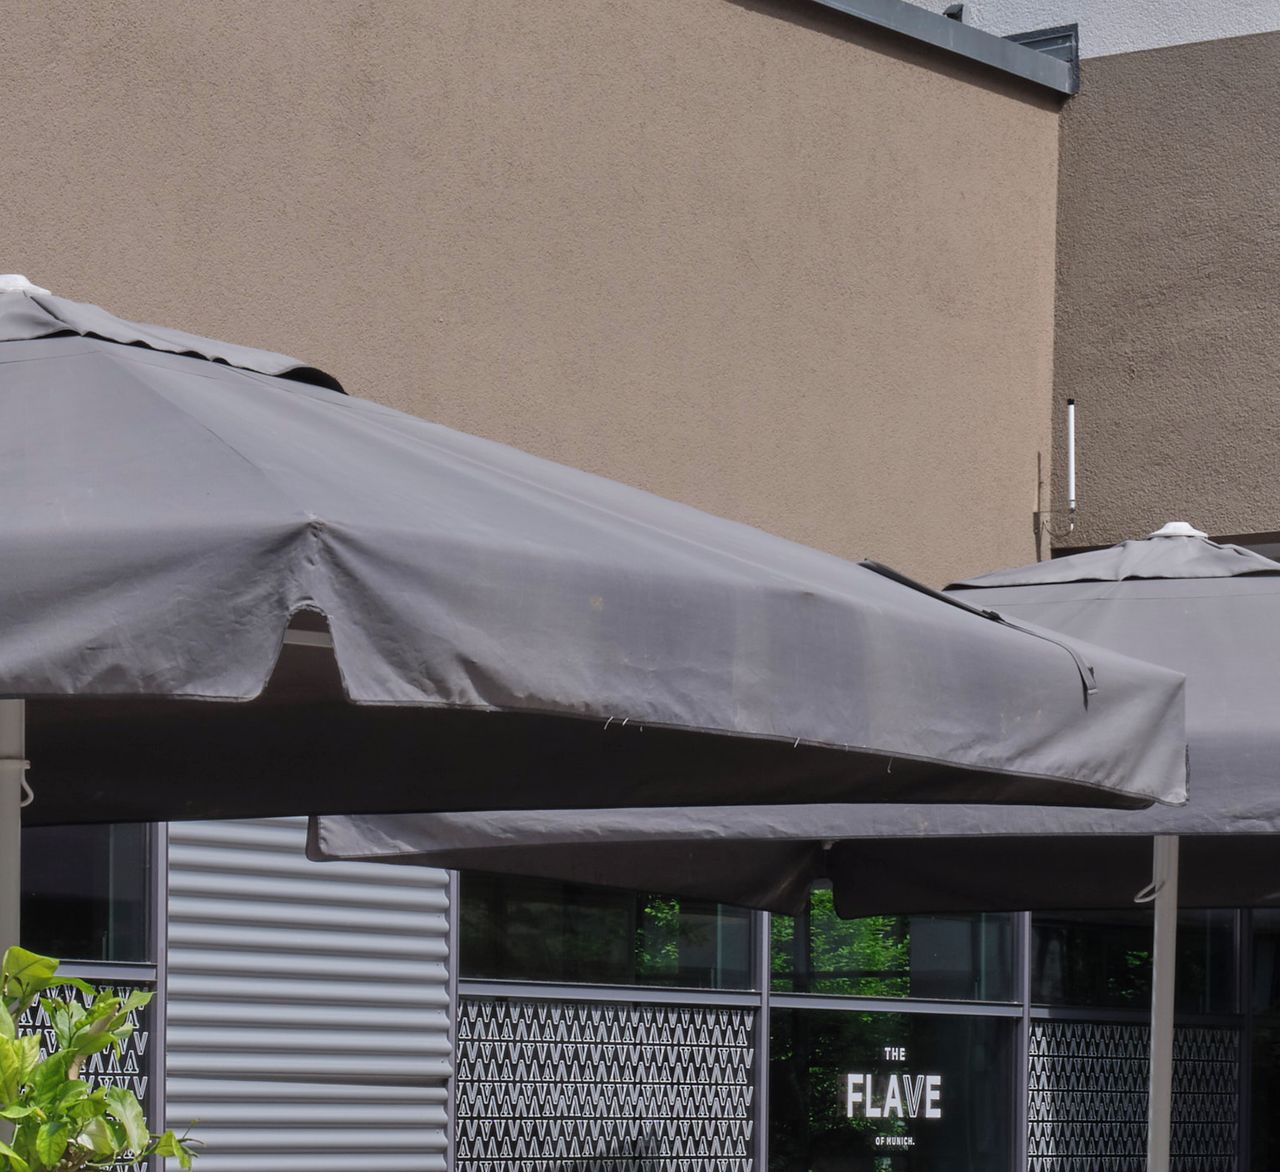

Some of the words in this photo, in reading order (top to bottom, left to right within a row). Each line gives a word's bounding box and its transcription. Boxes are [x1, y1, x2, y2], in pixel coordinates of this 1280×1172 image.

[884, 1047, 906, 1060] THE
[847, 1074, 941, 1117] FLAVE
[875, 1137, 885, 1146] OF
[886, 1137, 915, 1146] MUNICH.
